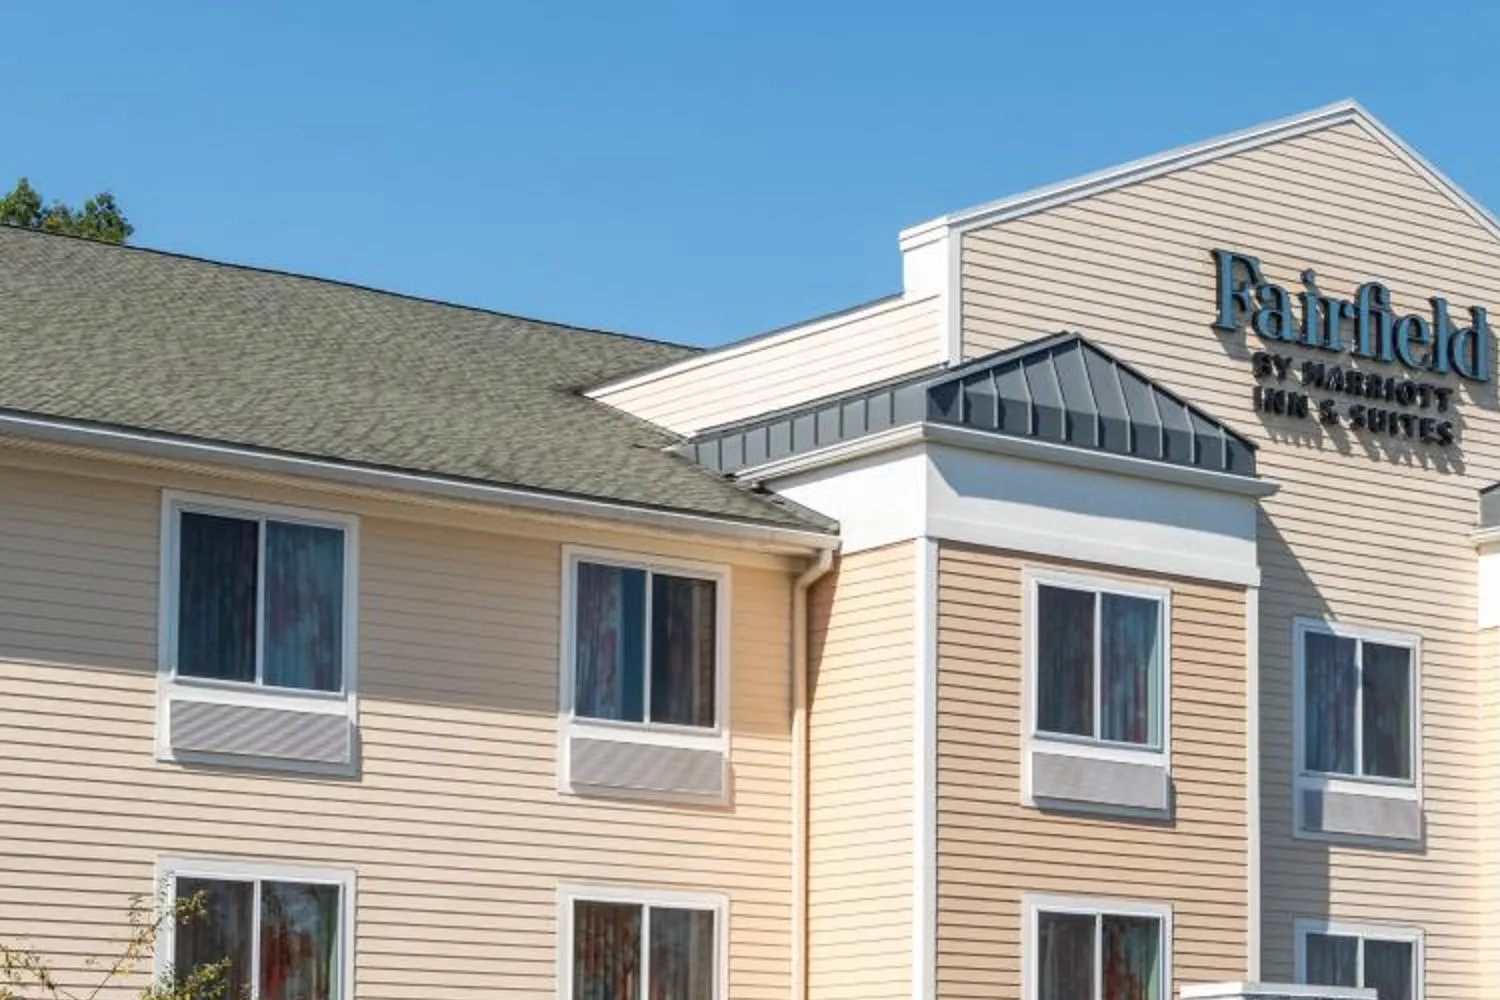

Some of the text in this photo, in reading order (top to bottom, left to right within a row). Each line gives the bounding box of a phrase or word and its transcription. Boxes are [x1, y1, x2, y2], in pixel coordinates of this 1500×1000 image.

[1211, 248, 1492, 382] Fairfield
[1251, 351, 1454, 413] BY MARRIOTT
[1253, 386, 1309, 419] INN
[1349, 404, 1454, 447] SUITES
